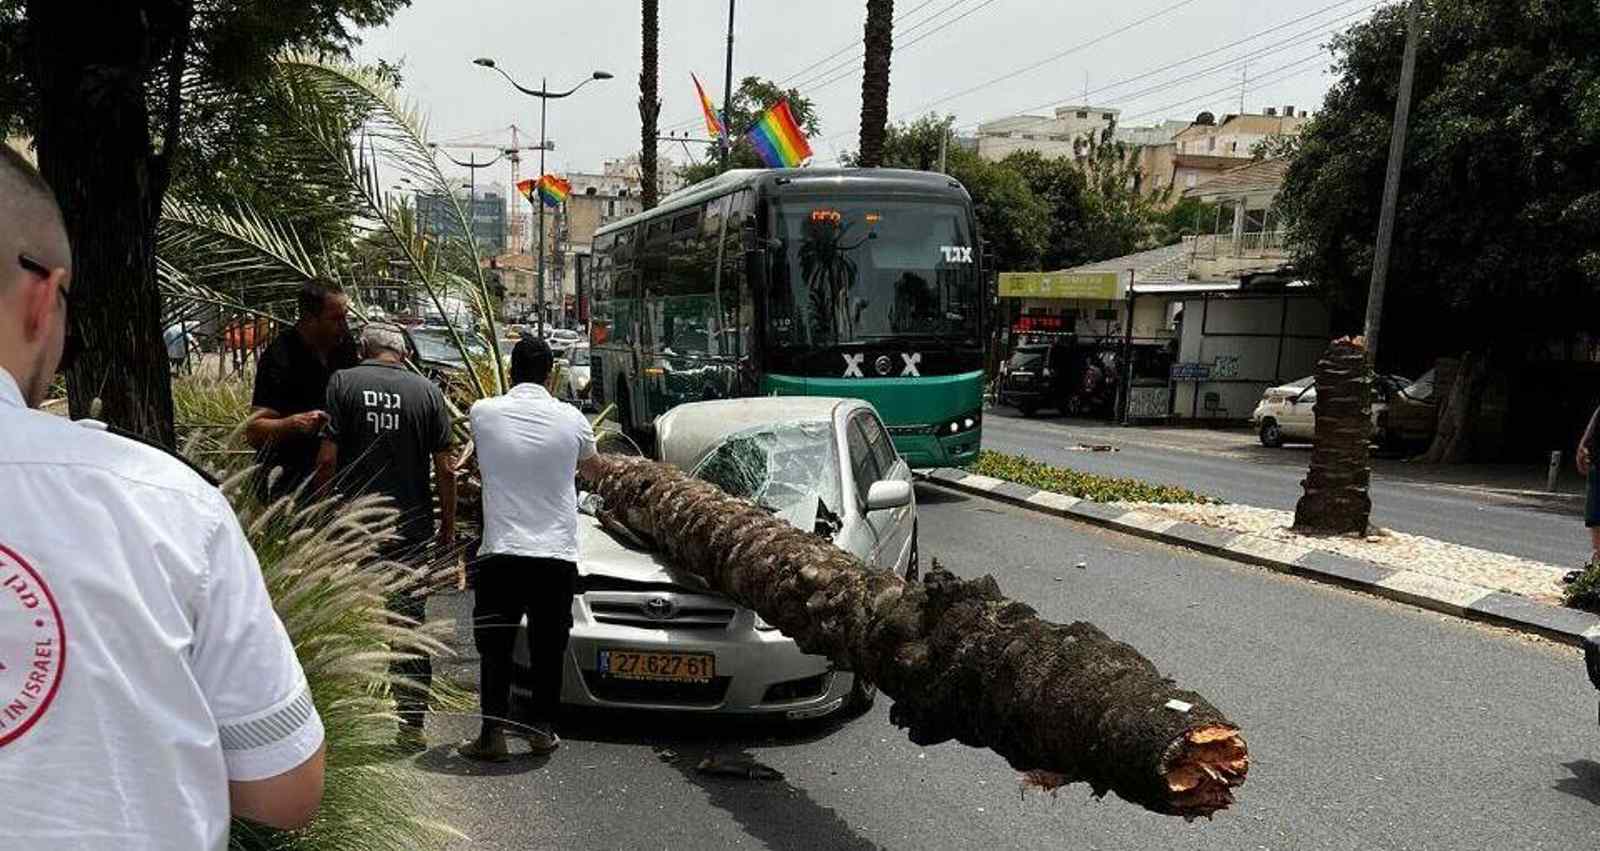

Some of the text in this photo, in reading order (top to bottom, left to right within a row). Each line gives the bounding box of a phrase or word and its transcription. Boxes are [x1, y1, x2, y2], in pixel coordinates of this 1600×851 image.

[940, 246, 973, 263] אגד
[363, 390, 401, 409] גנים
[366, 411, 399, 434] ונוף
[3, 638, 52, 720] IN ISRAEL
